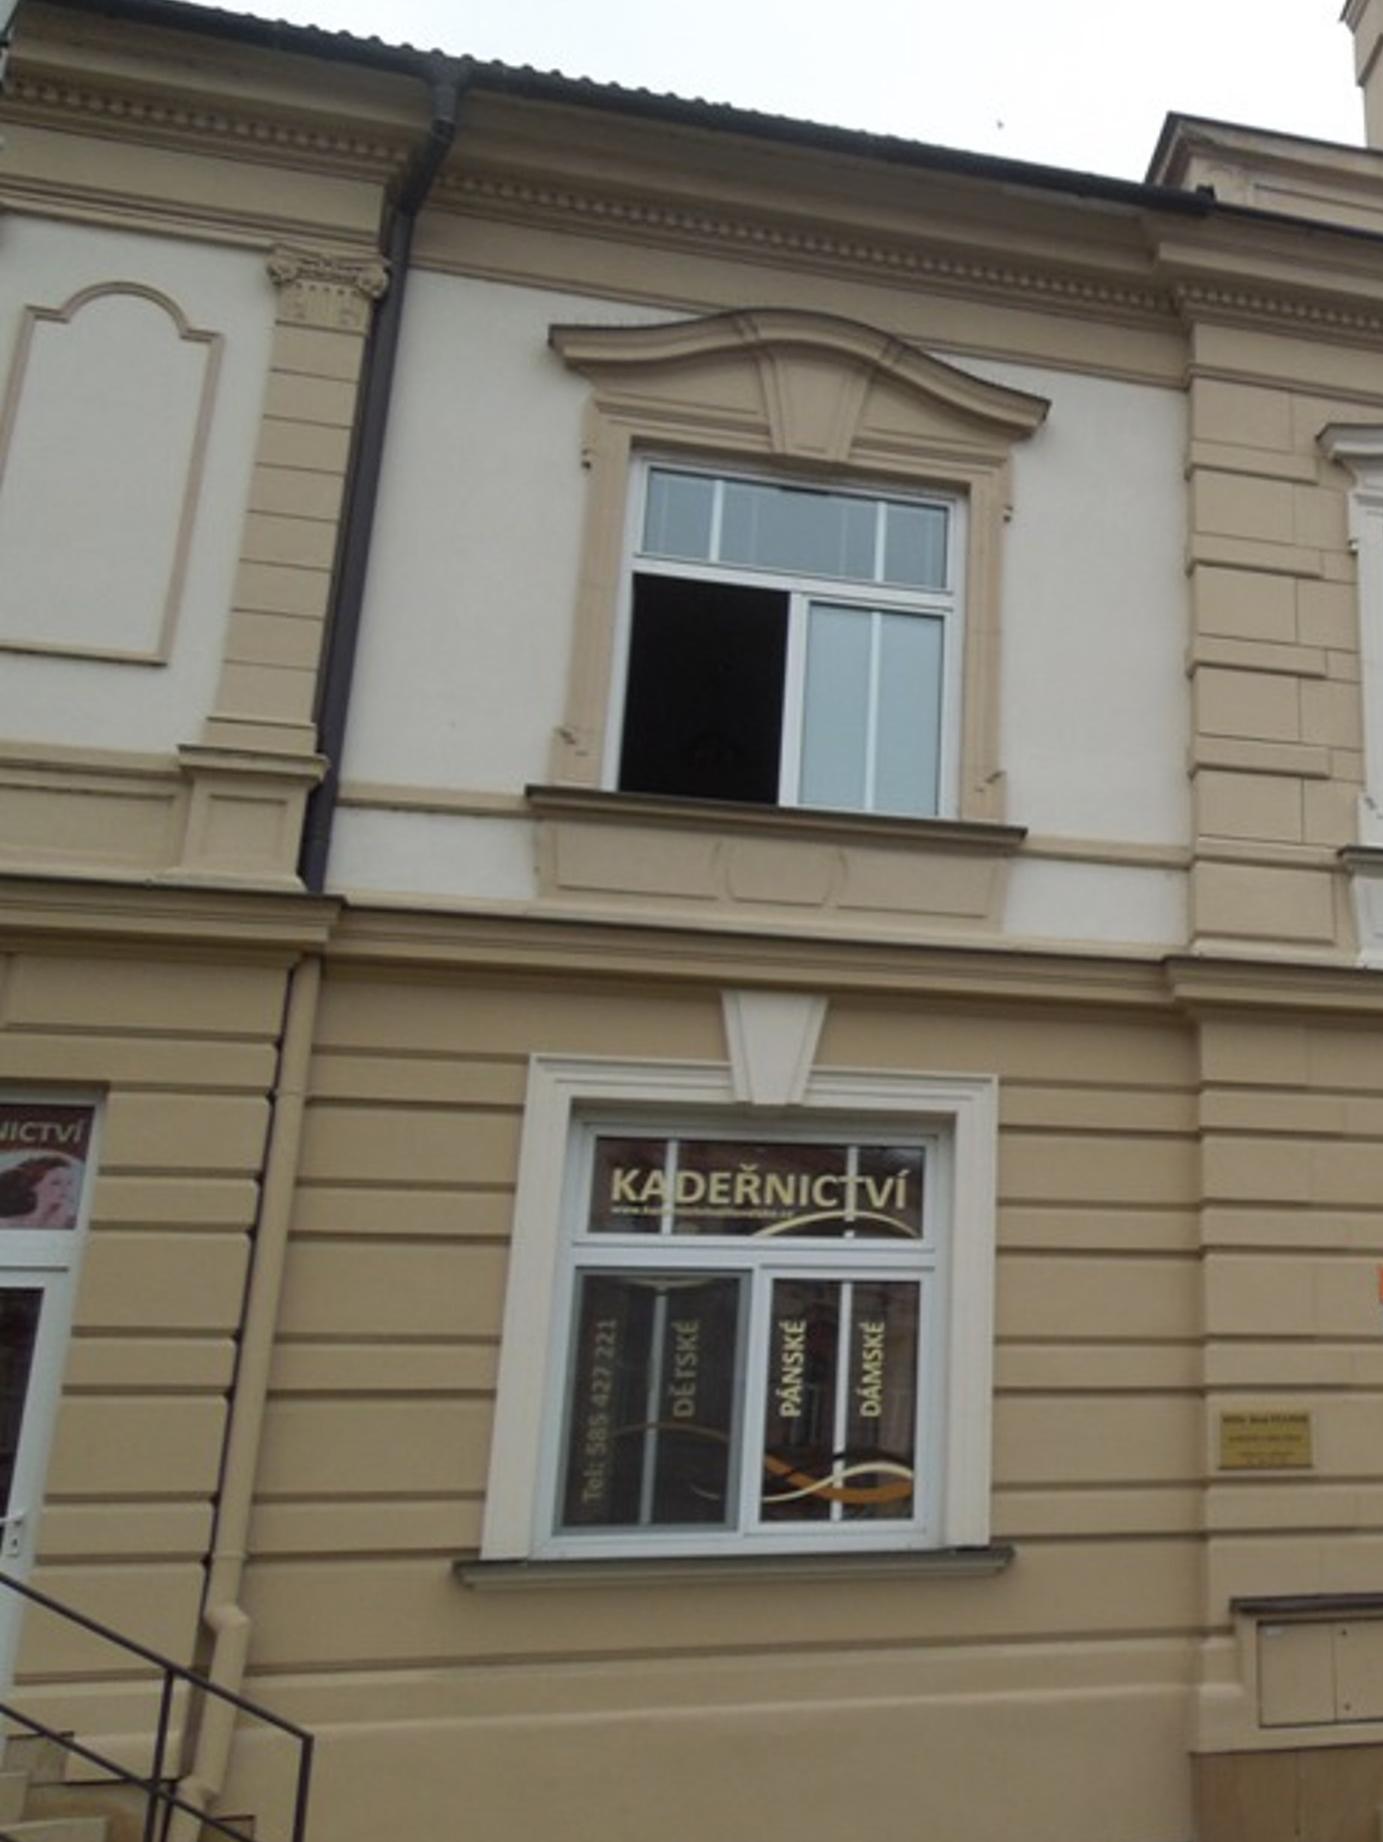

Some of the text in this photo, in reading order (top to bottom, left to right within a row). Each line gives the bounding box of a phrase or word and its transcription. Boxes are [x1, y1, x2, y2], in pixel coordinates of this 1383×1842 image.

[610, 1163, 909, 1209] KADEŘNICTVÍ
[668, 1318, 700, 1418] DĚTSKÉ
[776, 1318, 805, 1418] PÁNSKÉ
[856, 1320, 885, 1418] DÁMSKÉ
